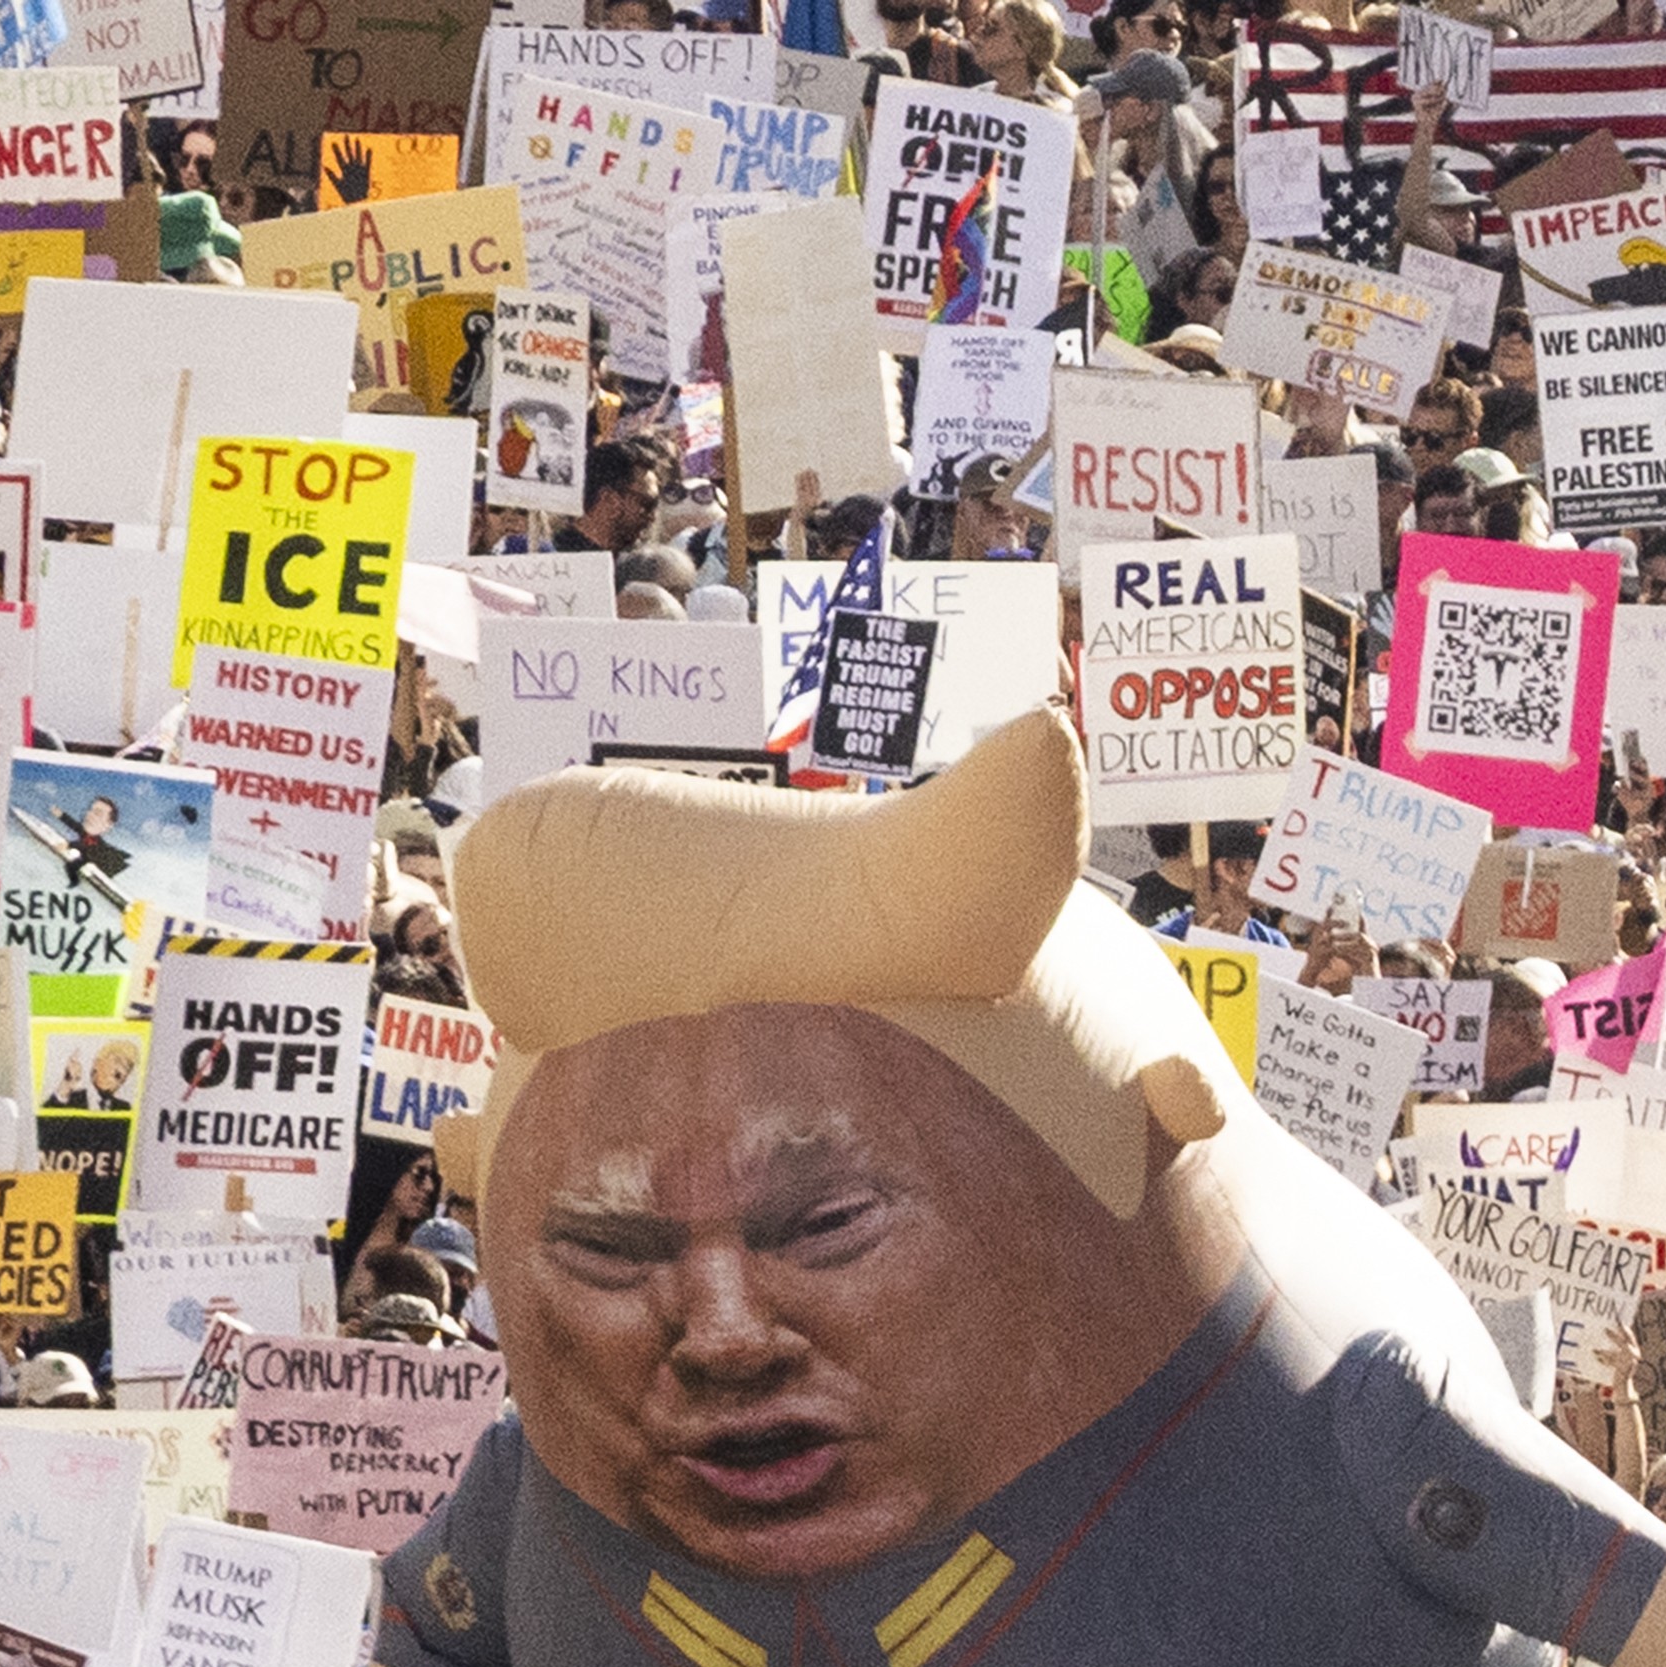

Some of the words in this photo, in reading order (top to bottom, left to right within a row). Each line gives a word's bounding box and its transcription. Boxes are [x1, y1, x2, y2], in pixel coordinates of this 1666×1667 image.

[211, 446, 390, 503] STOP
[1072, 442, 1248, 523] RESIST!
[262, 507, 318, 529] THE
[219, 531, 391, 616] ICE
[1115, 558, 1265, 608] REAL
[182, 619, 383, 664] KIDNAPPINGS
[866, 616, 905, 643] THE
[1089, 613, 1294, 653] AMERICANS
[836, 638, 927, 666] FASCIST
[217, 660, 362, 710] HISTORY
[514, 650, 577, 700] NO
[611, 656, 725, 701] KINGS
[838, 663, 916, 689] TRUMP
[1111, 666, 1296, 719] OPPOSE
[831, 687, 915, 711] REGIME
[836, 709, 899, 736] MUST
[844, 731, 883, 756] GO!
[1099, 725, 1294, 772] DICTATORS
[184, 998, 342, 1037] HANDS
[158, 1110, 343, 1151] MEDICARE
[182, 1552, 273, 1589] TRUMP
[172, 1587, 264, 1627] MUSK
